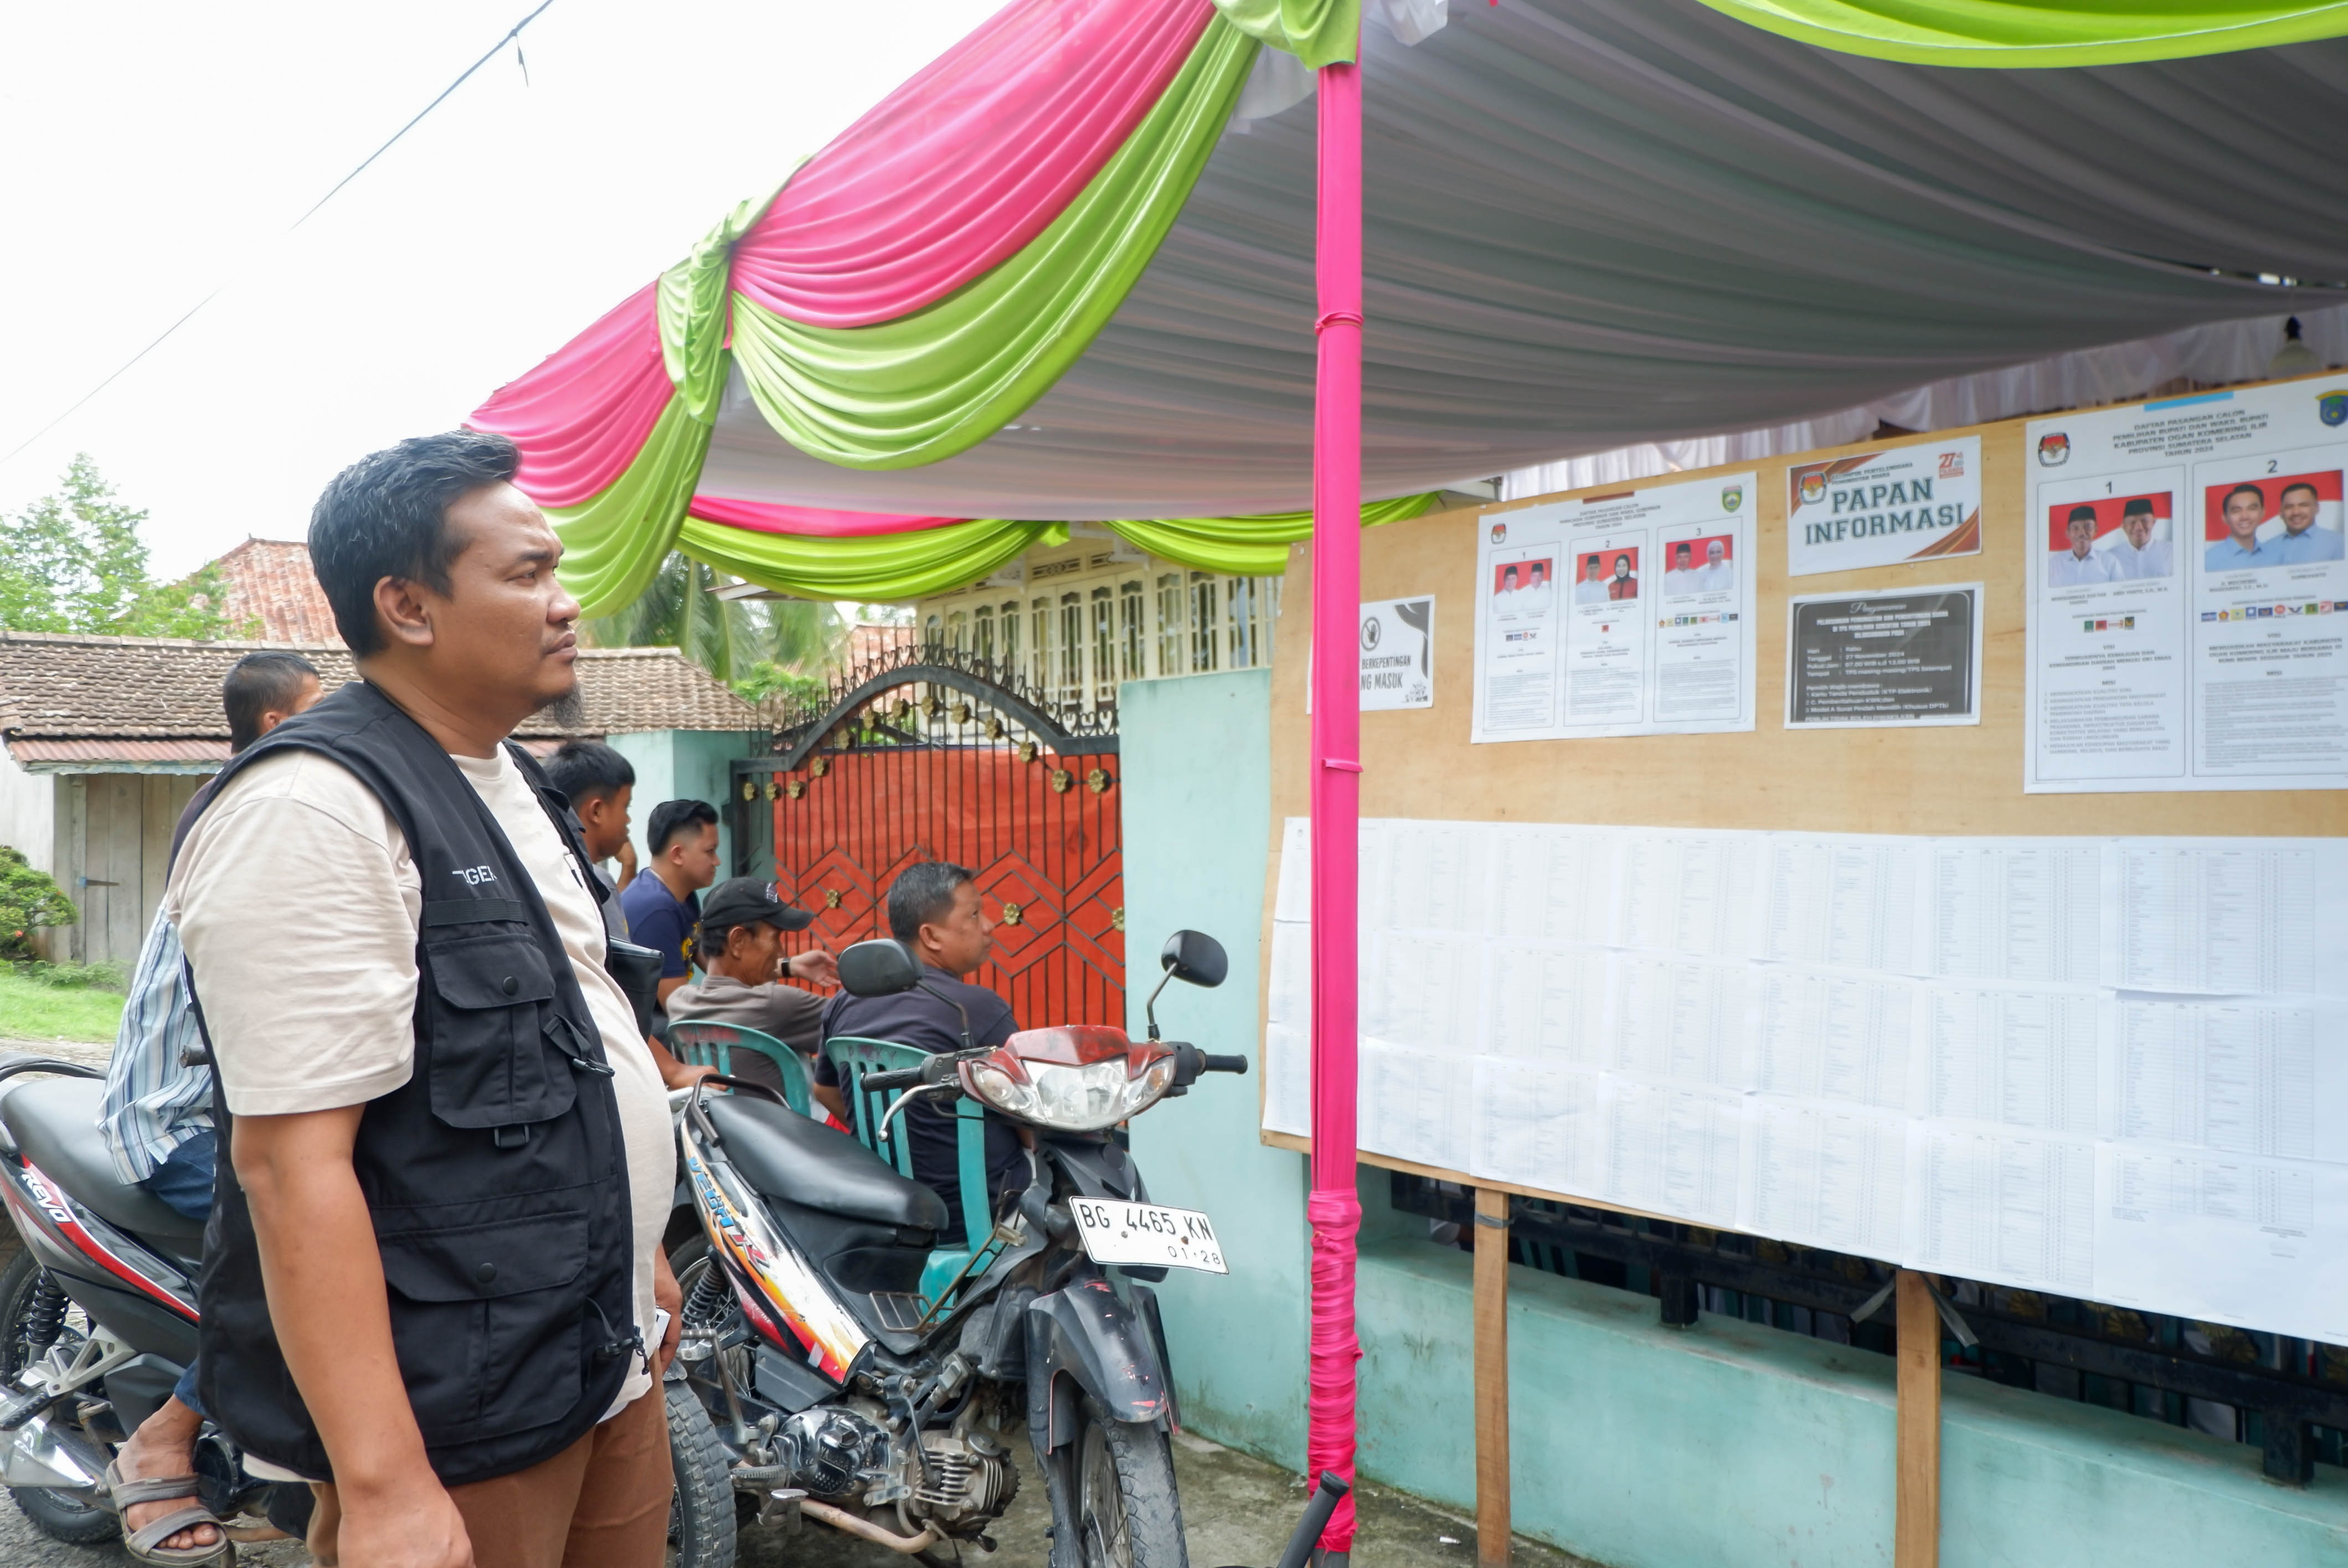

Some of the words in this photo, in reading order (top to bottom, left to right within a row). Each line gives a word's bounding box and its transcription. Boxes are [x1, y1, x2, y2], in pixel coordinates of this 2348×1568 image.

[2134, 421, 2165, 431] DAFTAR
[2167, 414, 2213, 425] PASANGAN
[2216, 410, 2245, 419] CALON
[2114, 437, 2165, 449] KABUPATEN
[2168, 432, 2194, 442] OGAN
[2197, 426, 2247, 437] KOMERING
[2129, 445, 2165, 455] PROVINSI
[2168, 438, 2212, 449] SUMATERA
[2216, 432, 2252, 443] SELATAN
[2165, 449, 2192, 457] TAHUN
[2268, 460, 2278, 473] 2
[1831, 477, 1934, 515] PAPAN
[2105, 482, 2113, 494] 1
[1805, 502, 1965, 546] INFORMASI
[1362, 655, 1411, 670] BERKEPENTINGAN
[1374, 672, 1403, 690] MASUK
[21, 1172, 72, 1223] REVO
[1079, 1204, 1110, 1228] BG
[1126, 1209, 1176, 1235] 4465
[1183, 1216, 1213, 1241] KN
